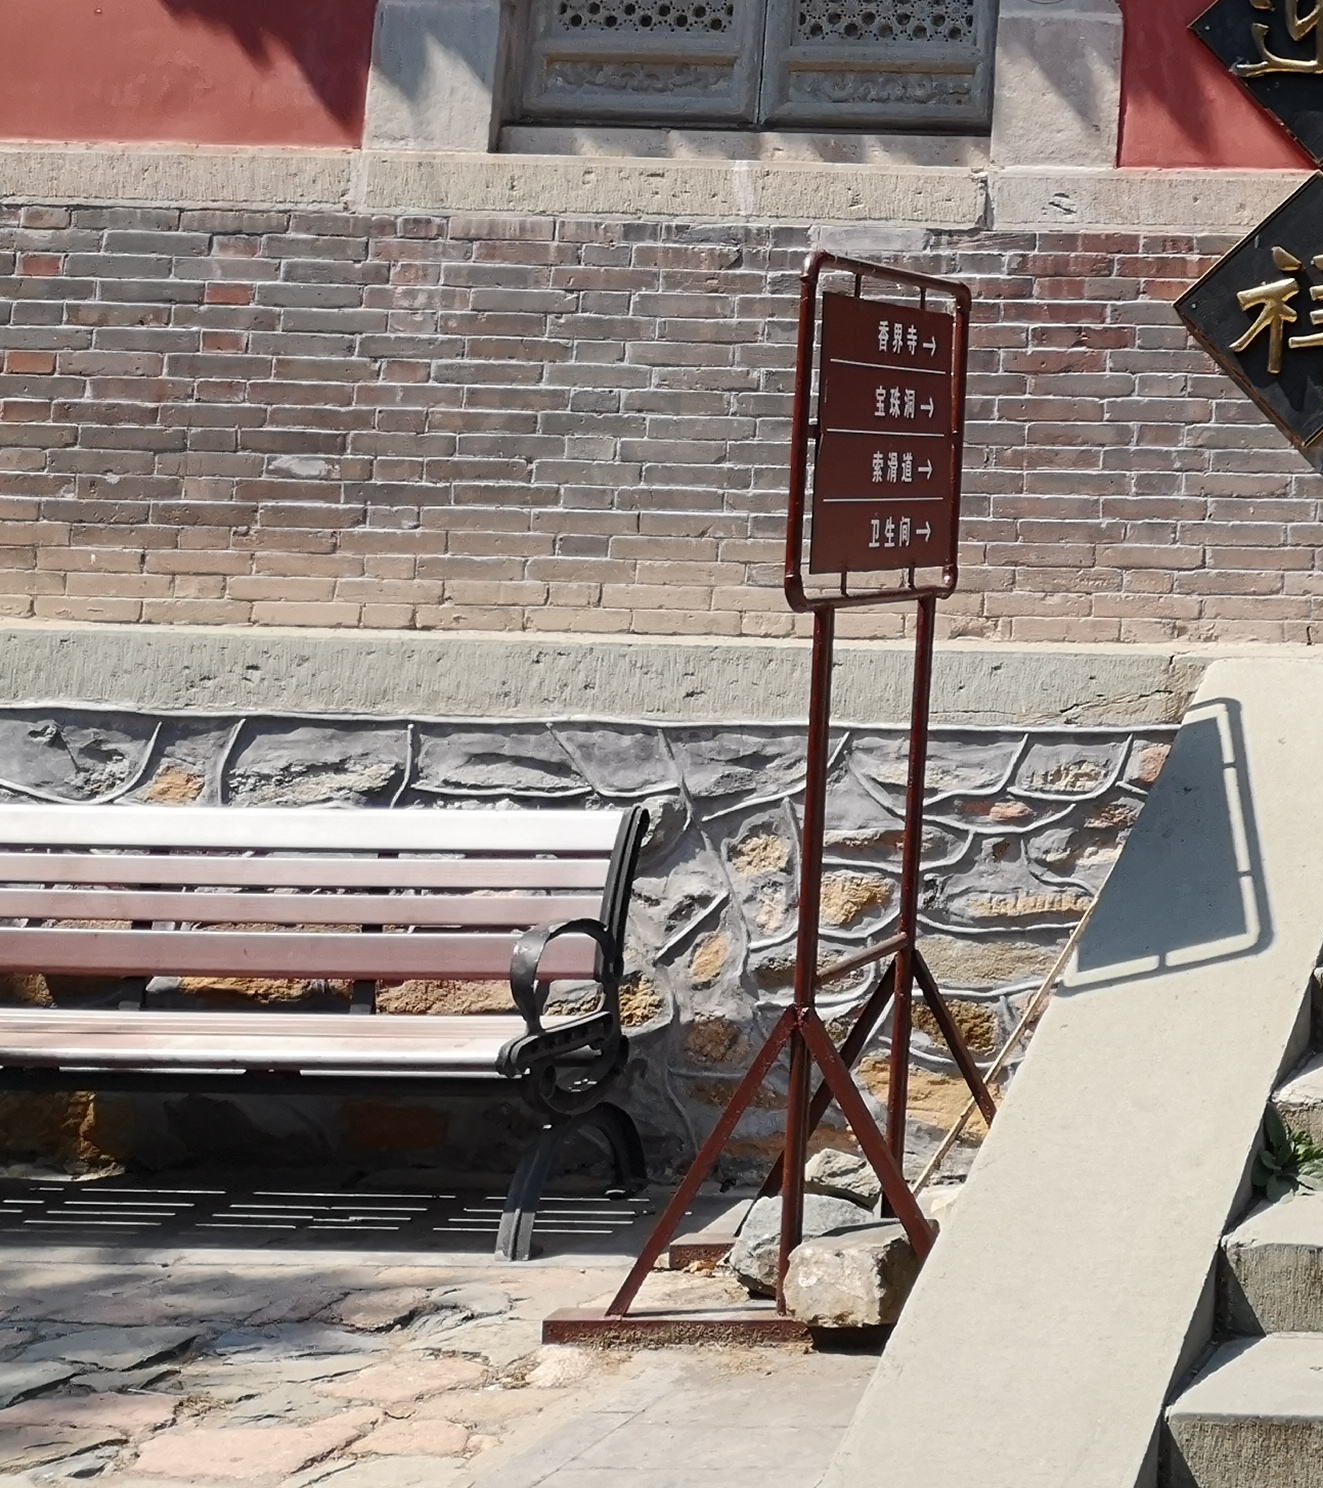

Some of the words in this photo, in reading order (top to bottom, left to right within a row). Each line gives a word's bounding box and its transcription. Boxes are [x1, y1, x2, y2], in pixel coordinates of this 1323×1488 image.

[877, 320, 918, 355] 香界寺
[874, 385, 916, 420] 宝珠洞
[871, 451, 914, 484] 索滑道
[868, 516, 911, 549] 卫生间
